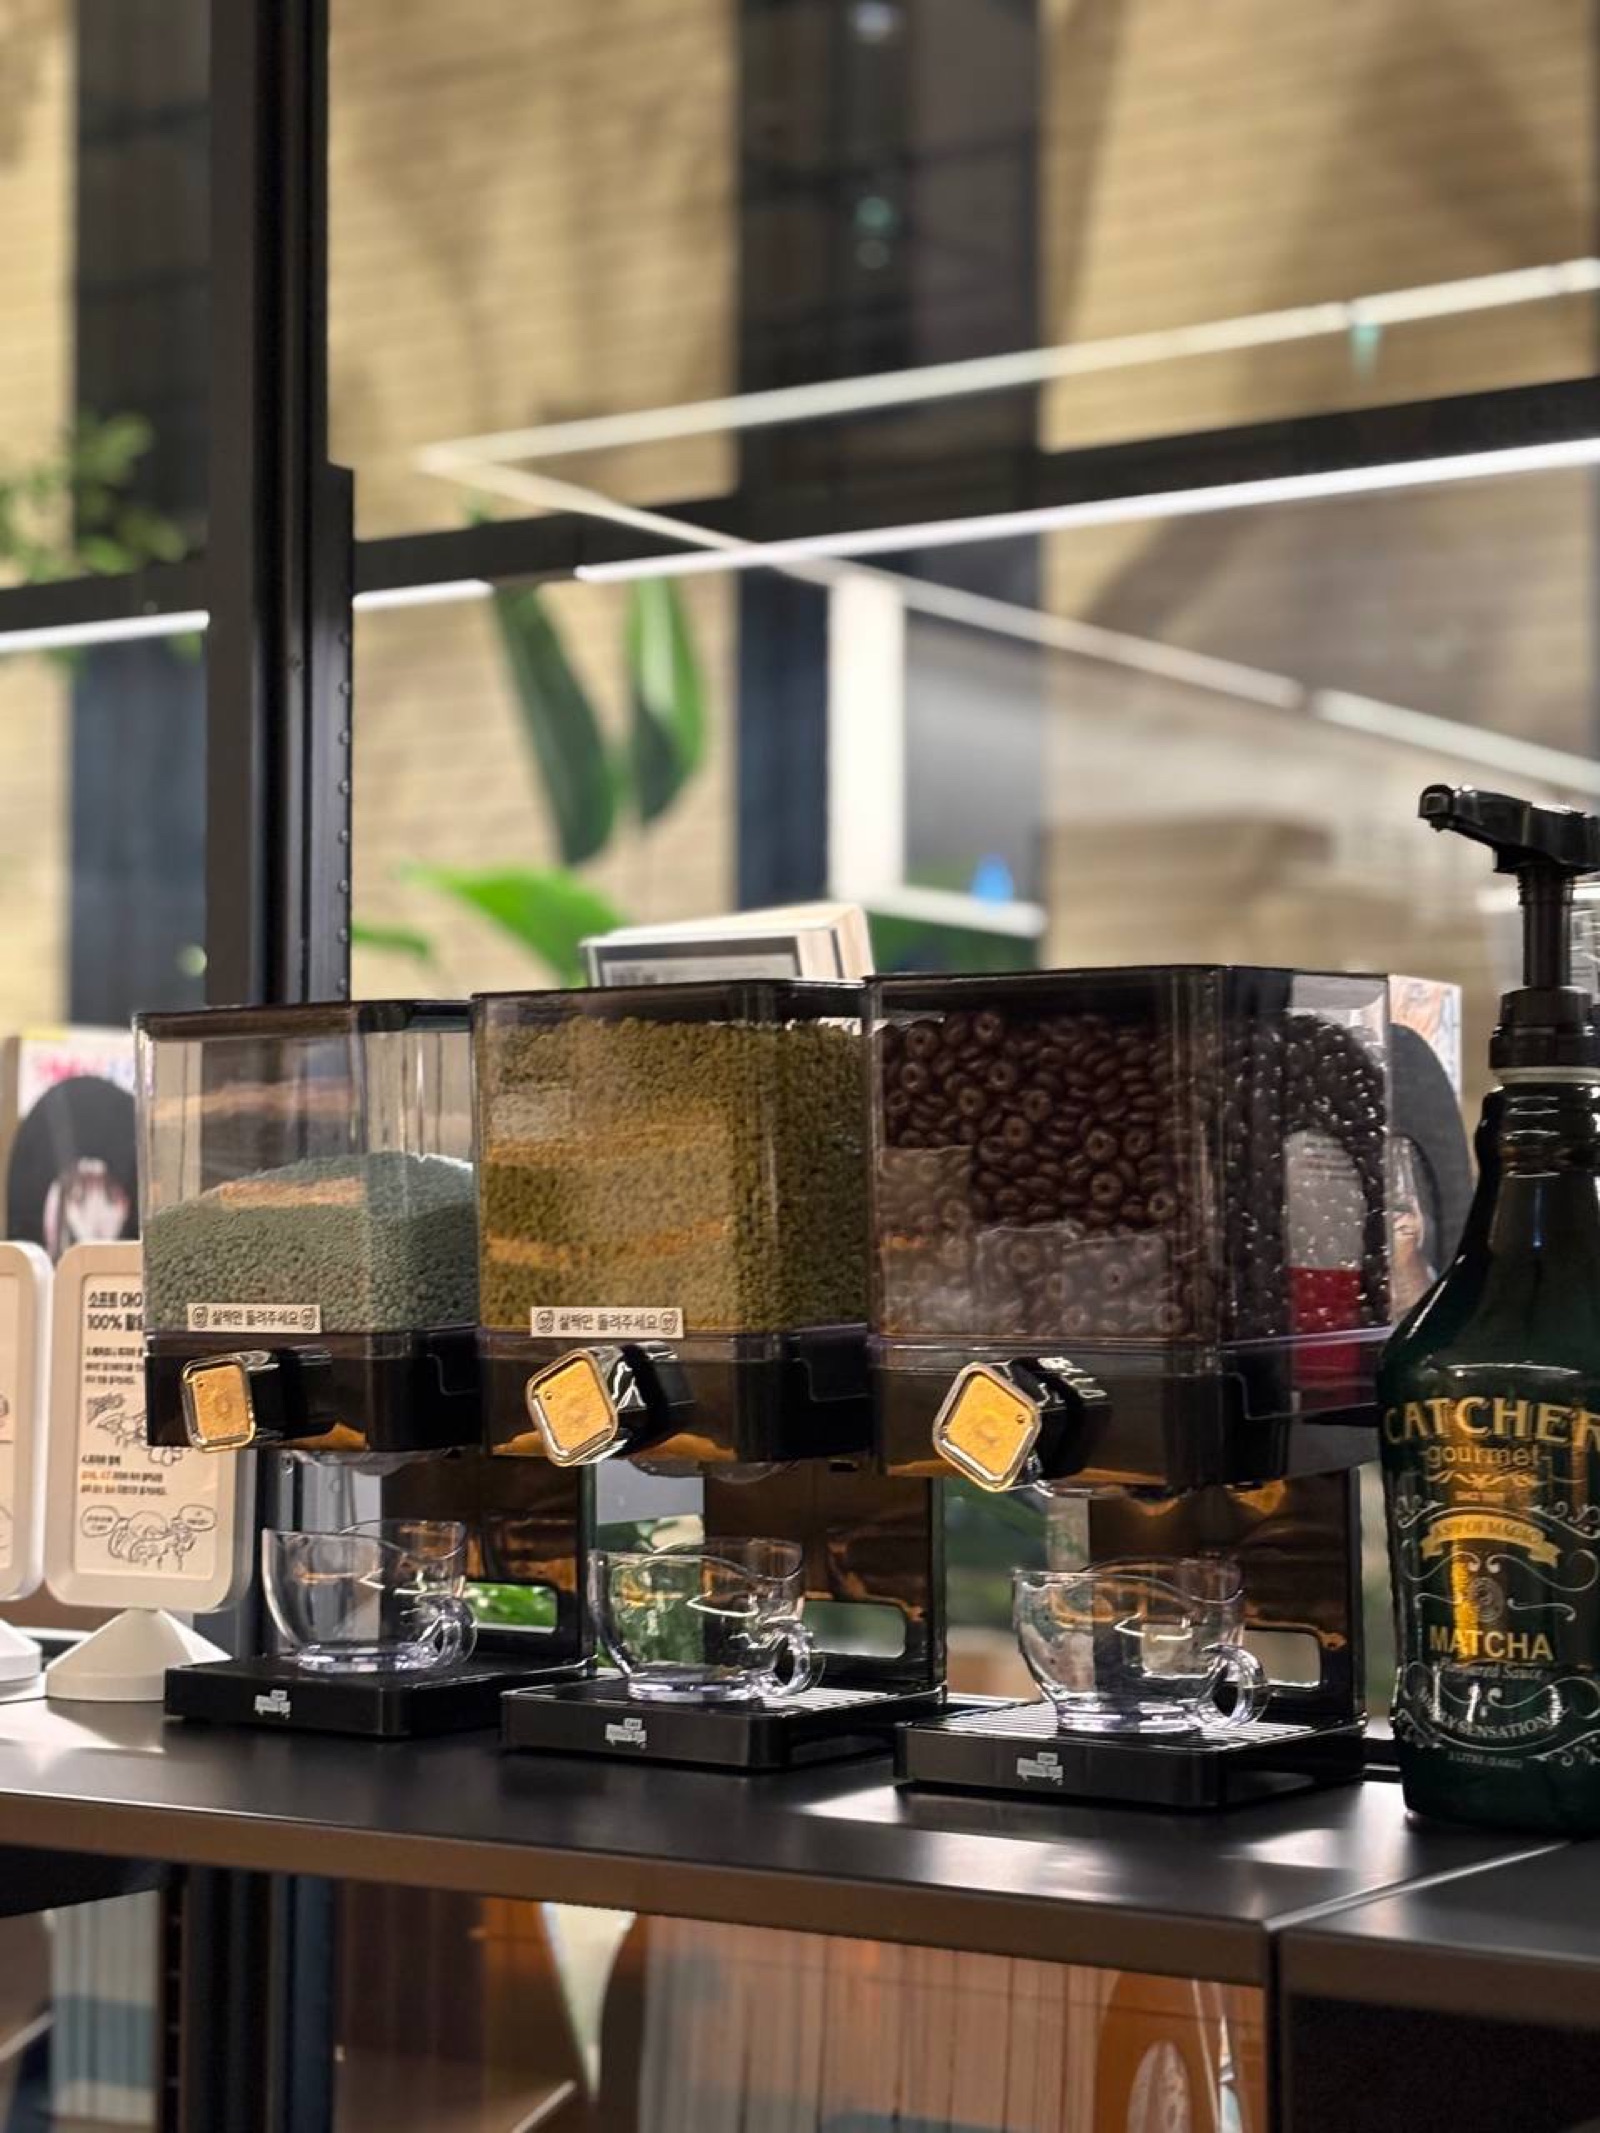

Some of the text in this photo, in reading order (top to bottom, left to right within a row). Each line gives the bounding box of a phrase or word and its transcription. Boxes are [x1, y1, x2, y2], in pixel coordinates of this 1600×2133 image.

[87, 1291, 117, 1308] 소프트
[87, 1313, 122, 1331] 100%
[597, 1313, 658, 1331] 돌려주세요
[1427, 1444, 1541, 1470] gourmet
[1429, 1625, 1554, 1661] MATCHA
